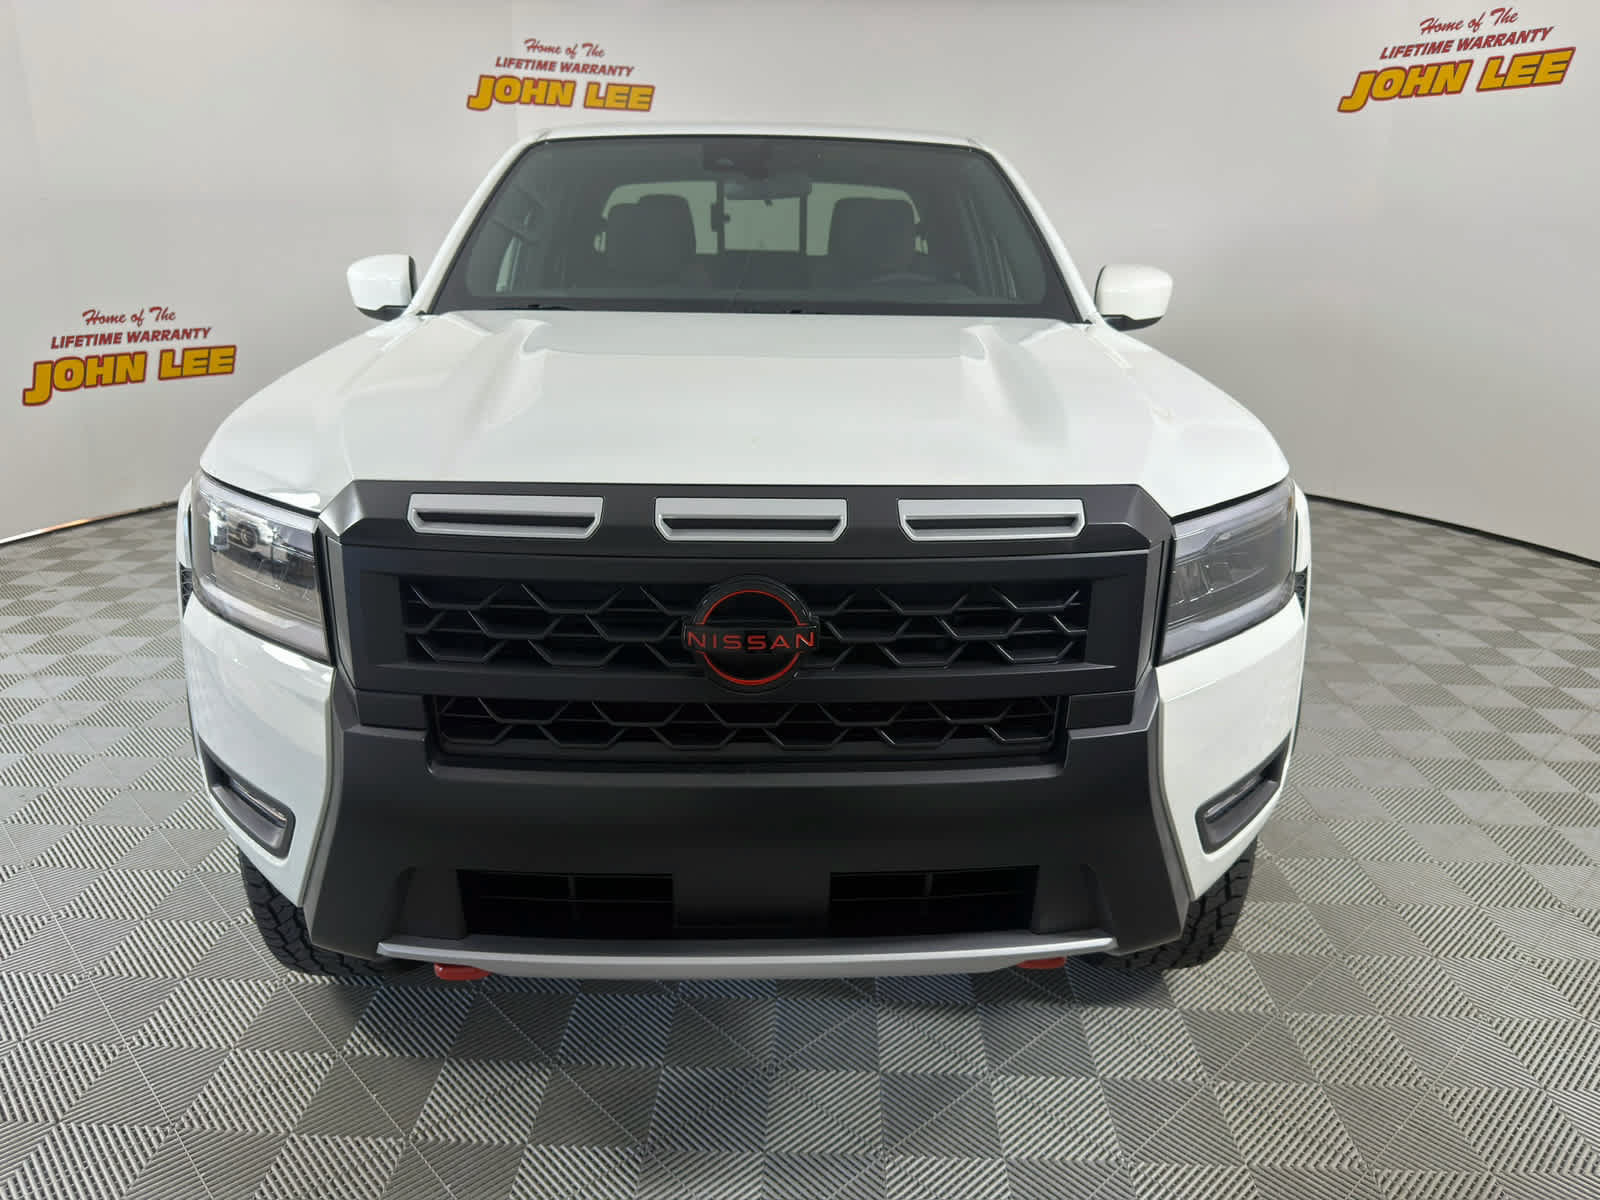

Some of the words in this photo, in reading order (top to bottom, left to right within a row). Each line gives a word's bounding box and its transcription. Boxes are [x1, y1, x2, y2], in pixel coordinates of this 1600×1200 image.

[1419, 17, 1464, 35] Home
[1467, 12, 1485, 32] of
[1490, 7, 1519, 25] The
[524, 38, 561, 54] Home
[565, 43, 578, 59] of
[582, 43, 605, 58] The
[1379, 39, 1454, 60] LIFETIME
[1457, 26, 1554, 51] WARRANTY
[495, 56, 556, 72] LIFETIME
[560, 61, 634, 77] WARRANTY
[1337, 59, 1474, 113] JOHN
[1476, 46, 1576, 92] LEE
[467, 74, 577, 111] JOHN
[583, 81, 656, 112] LEE
[82, 309, 126, 326] Home
[130, 309, 145, 326] of
[149, 306, 176, 323] The
[51, 332, 123, 349] LIFETIME
[127, 327, 212, 344] WARRANTY
[22, 350, 148, 406] JOHN
[158, 345, 237, 380] LEE
[687, 631, 816, 650] NISSAN
